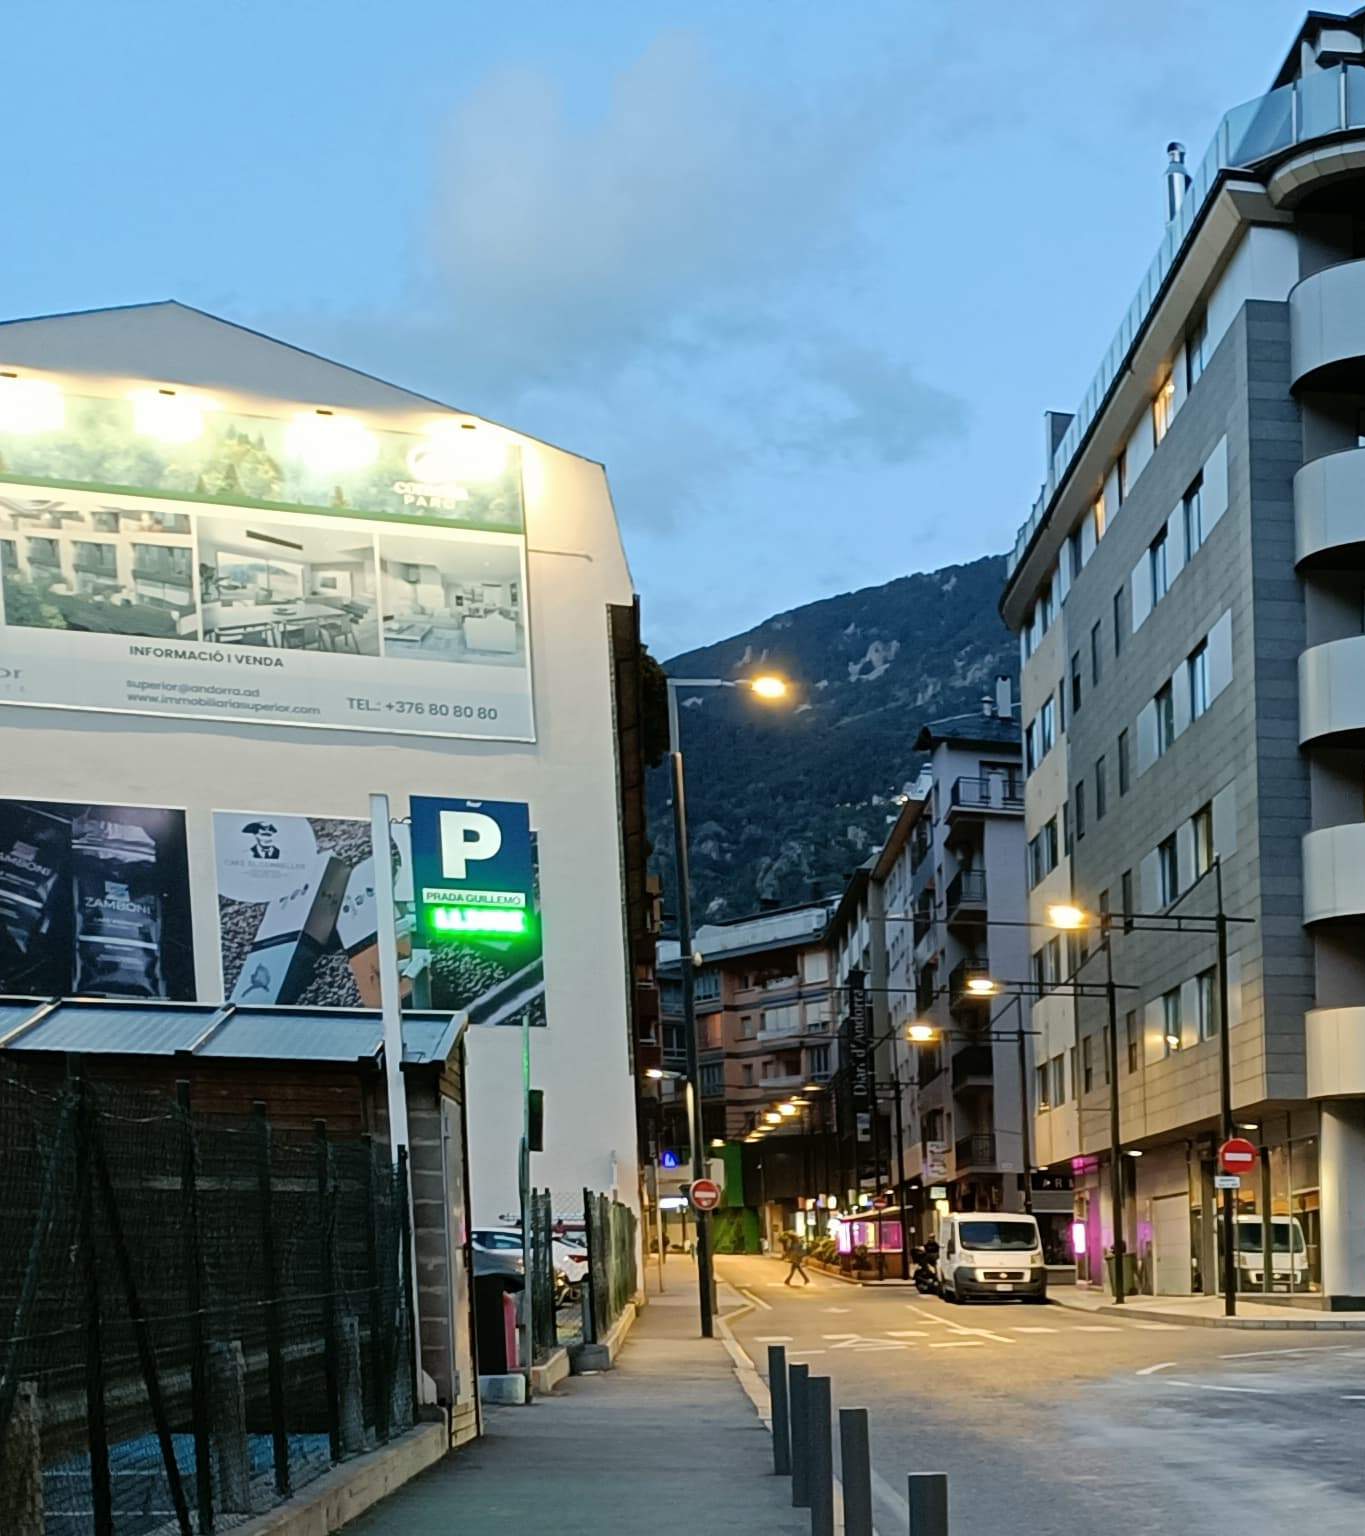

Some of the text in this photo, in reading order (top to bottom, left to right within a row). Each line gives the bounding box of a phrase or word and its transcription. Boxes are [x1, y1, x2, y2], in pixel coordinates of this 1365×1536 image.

[129, 645, 223, 663] INFORMACIÓ
[236, 654, 284, 667] VENDA
[126, 679, 260, 697] superior@andorra.ad
[385, 701, 425, 715] +376
[428, 703, 449, 717] 80
[453, 706, 474, 719] 80
[477, 707, 498, 721] 80
[440, 811, 502, 879] P
[0, 853, 51, 876] AMBONI
[85, 897, 152, 915] ZAMBONI
[426, 891, 463, 902] PRADA
